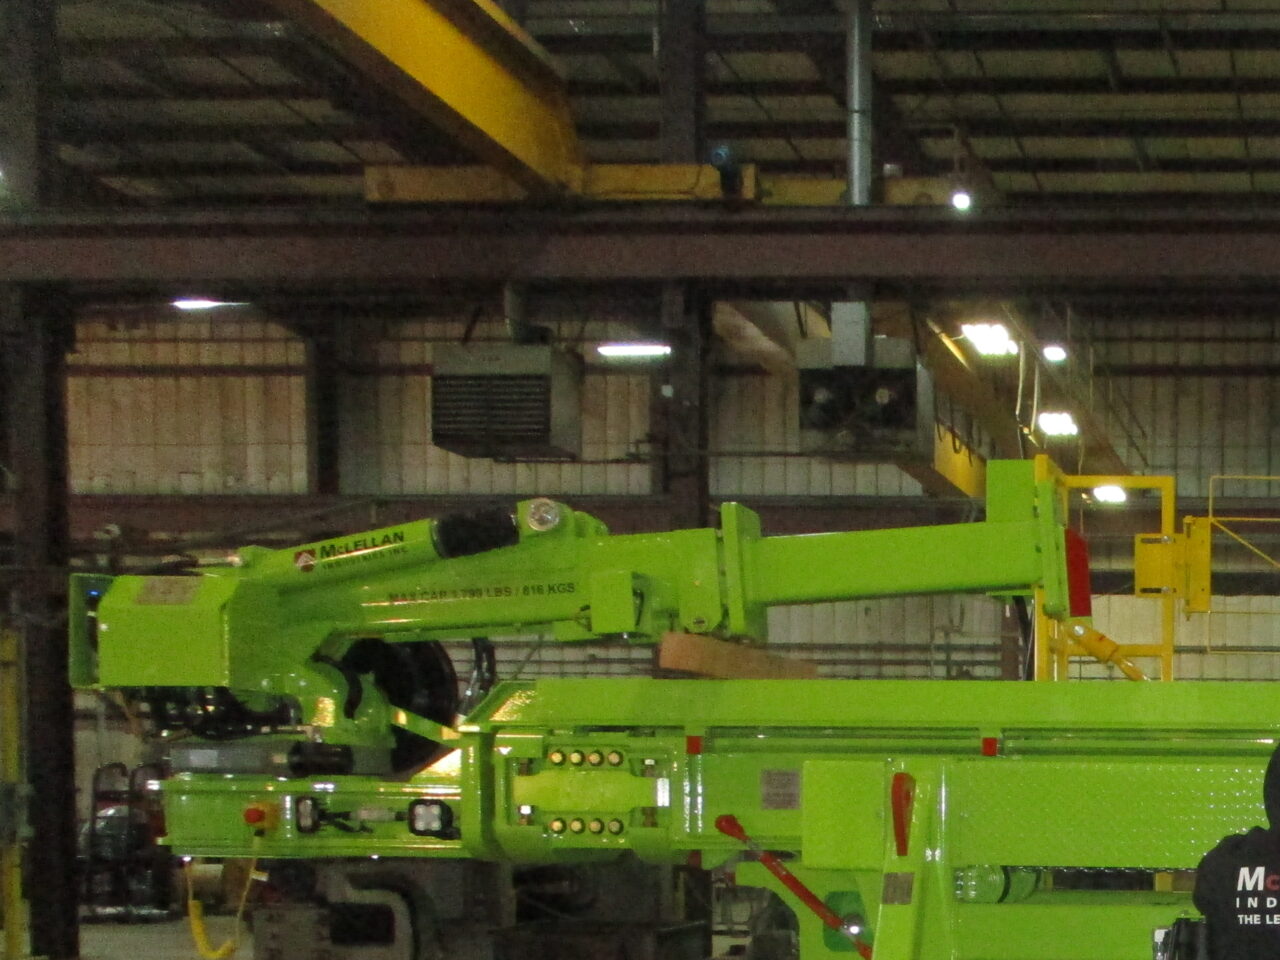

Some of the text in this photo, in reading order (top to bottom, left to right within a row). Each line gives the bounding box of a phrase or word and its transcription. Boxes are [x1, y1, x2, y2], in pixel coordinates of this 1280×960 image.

[487, 587, 512, 598] LBS
[548, 582, 575, 594] KGS
[1237, 914, 1261, 925] THE
